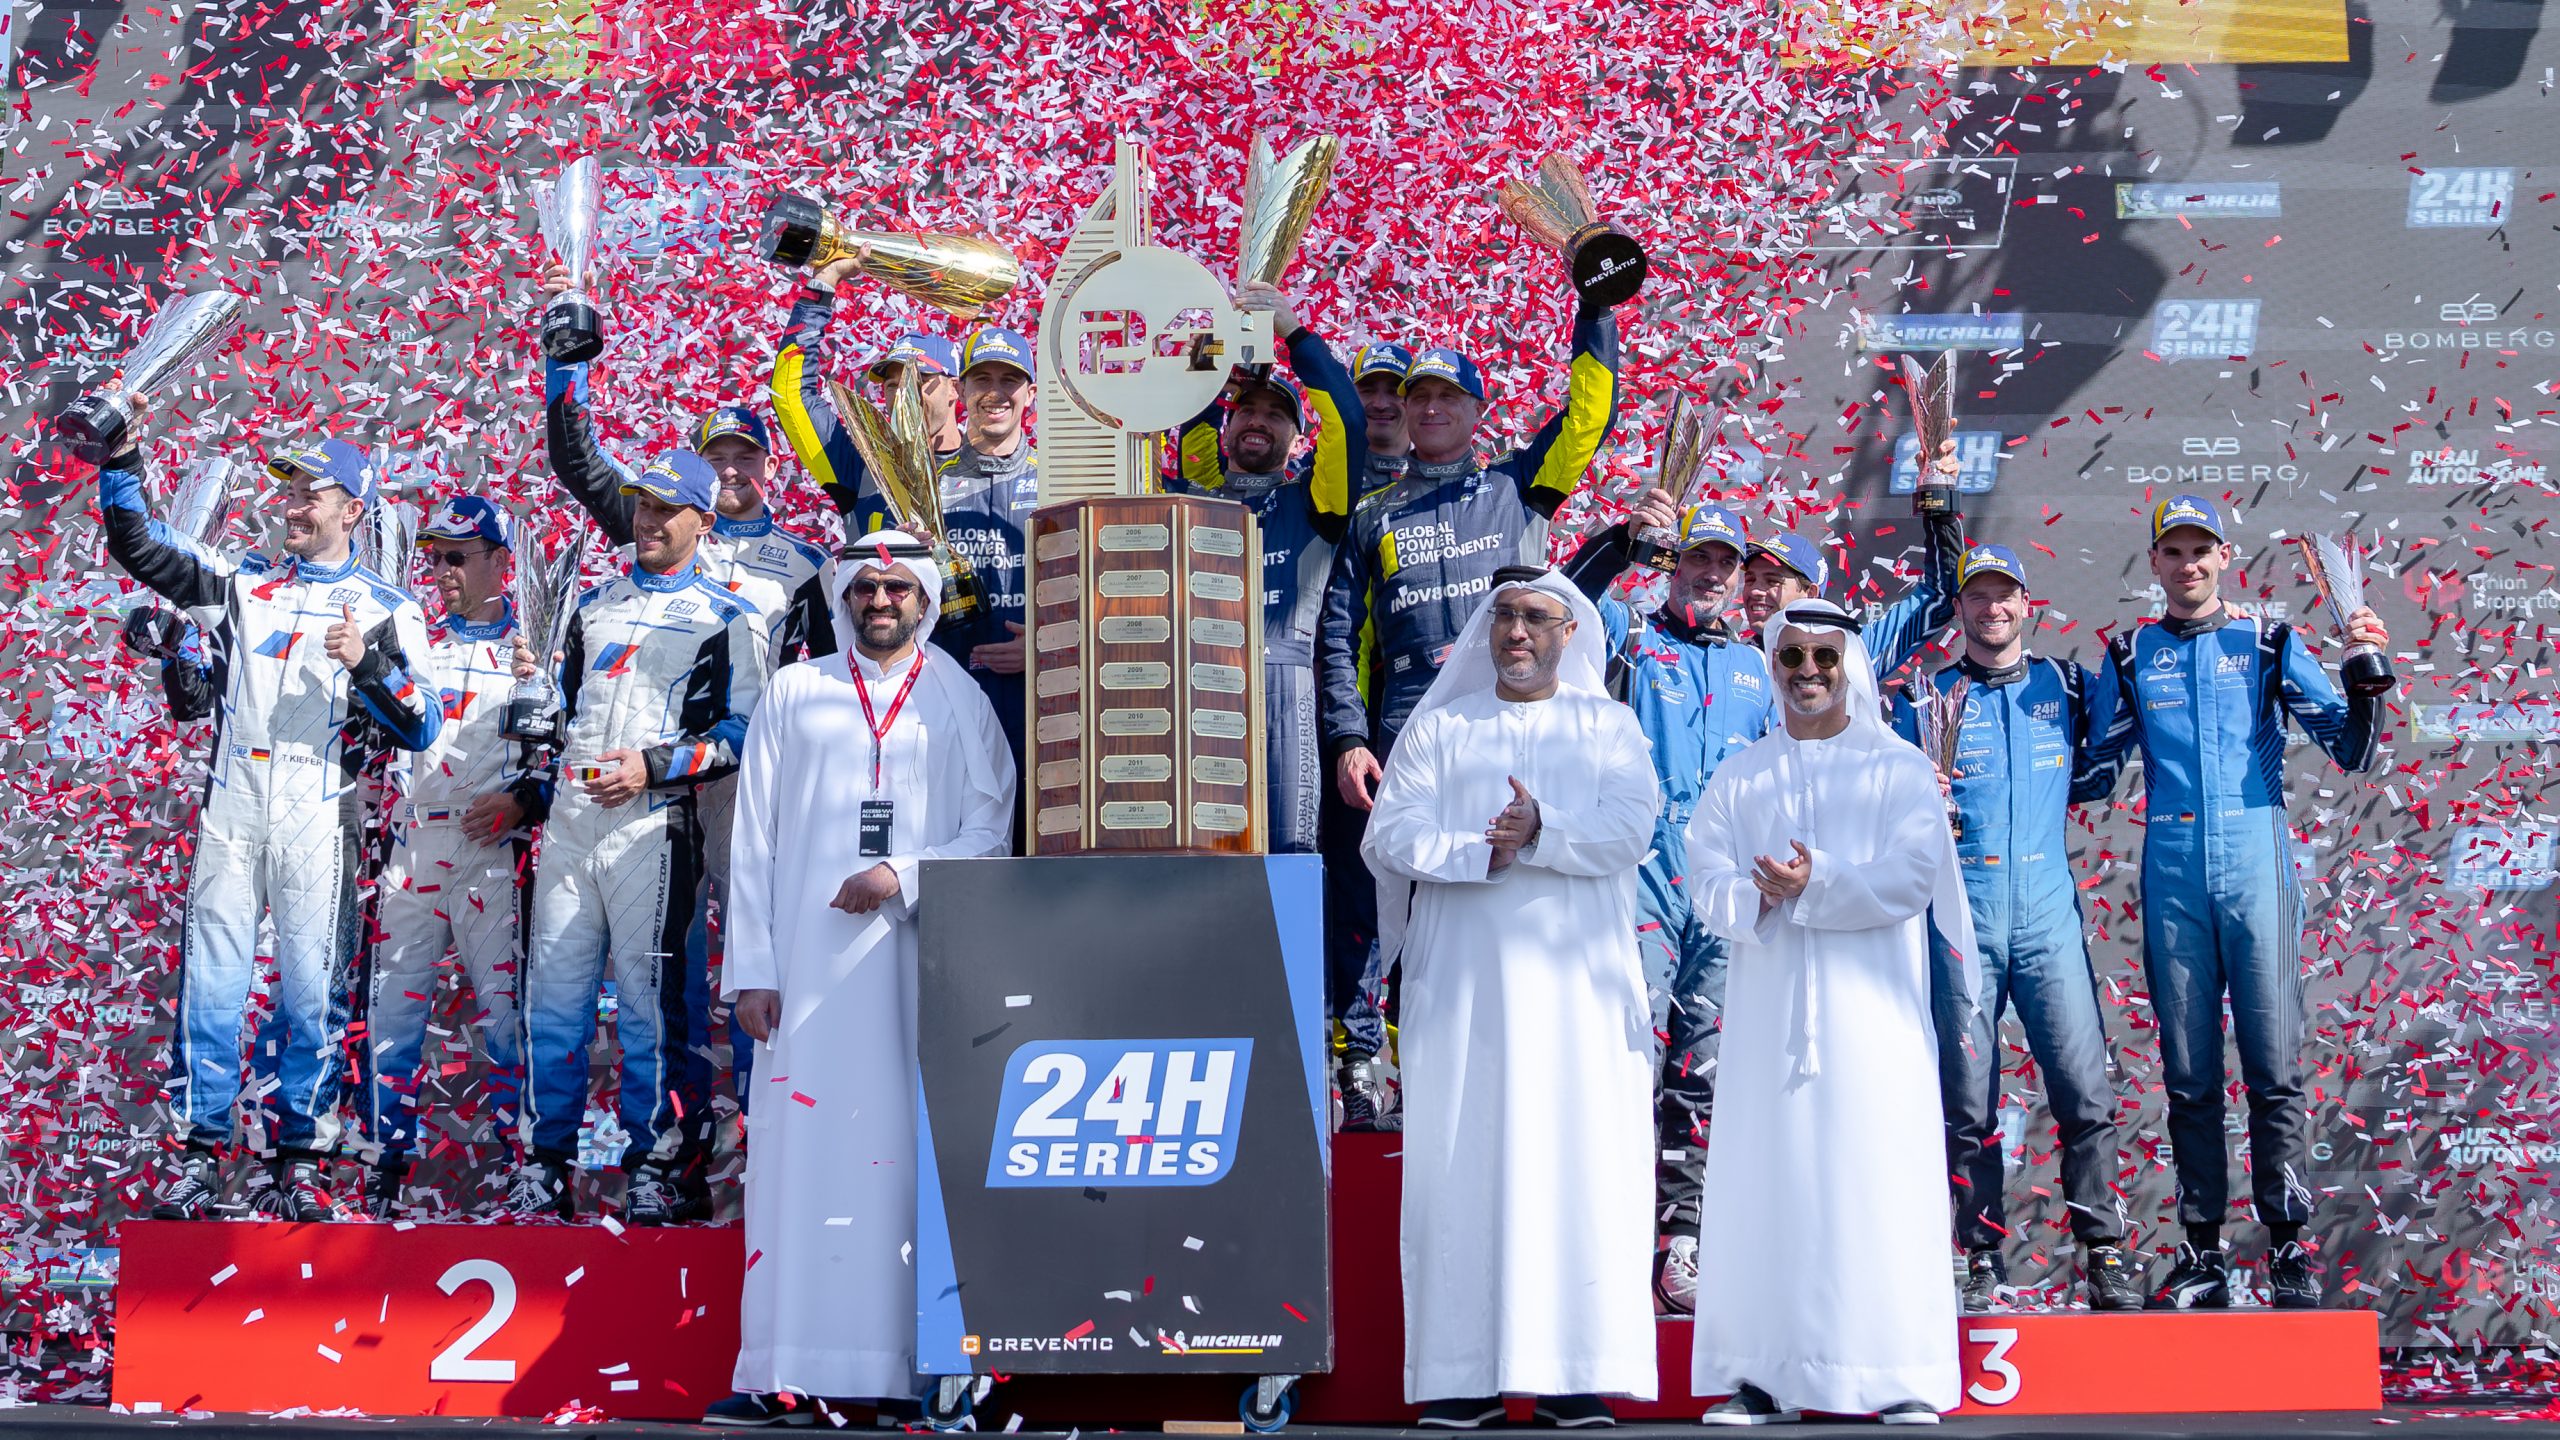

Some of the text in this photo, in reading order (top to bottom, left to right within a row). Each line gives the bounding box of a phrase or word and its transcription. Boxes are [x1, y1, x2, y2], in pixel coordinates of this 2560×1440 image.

[2415, 170, 2510, 208] 24H
[2413, 209, 2506, 224] SERIES
[1583, 257, 1637, 287] CREVENTIC
[2160, 303, 2253, 340] 24H
[1903, 326, 2021, 342] MICHELIN
[2385, 330, 2555, 349] BOMBERG
[973, 345, 1020, 358] MICHELIN
[2158, 340, 2251, 356] SERIES
[1363, 358, 1408, 370] MICHELIN
[1411, 362, 1456, 375] MICHELIN
[2128, 465, 2299, 484] BOMBERG
[2163, 511, 2208, 523] MICHELIN
[946, 528, 1006, 542] GLOBAL
[1395, 521, 1454, 541] GLOBAL
[1690, 523, 1736, 538] MICHELIN
[1396, 533, 1457, 555] POWER
[1964, 560, 2008, 573] MICHELIN
[1394, 657, 1411, 670] OMP
[2217, 655, 2250, 667] 24H
[1733, 671, 1760, 685] 24H
[2033, 702, 2060, 715] 24H
[530, 717, 555, 731] PLACE
[232, 745, 248, 756] OMP
[289, 755, 323, 767] KIEFER
[1963, 763, 1986, 774] IWC
[2151, 814, 2174, 823] HRX
[2224, 809, 2245, 817] STOLZ
[323, 835, 340, 972] W-RACINGTEAM.COM
[1012, 1050, 1236, 1137] 24H
[1005, 1141, 1220, 1177] SERIES
[430, 1258, 518, 1382] 2
[989, 1337, 1113, 1352] CREVENTIC
[1191, 1335, 1282, 1347] MICHELIN
[1967, 1328, 2022, 1405] 3
